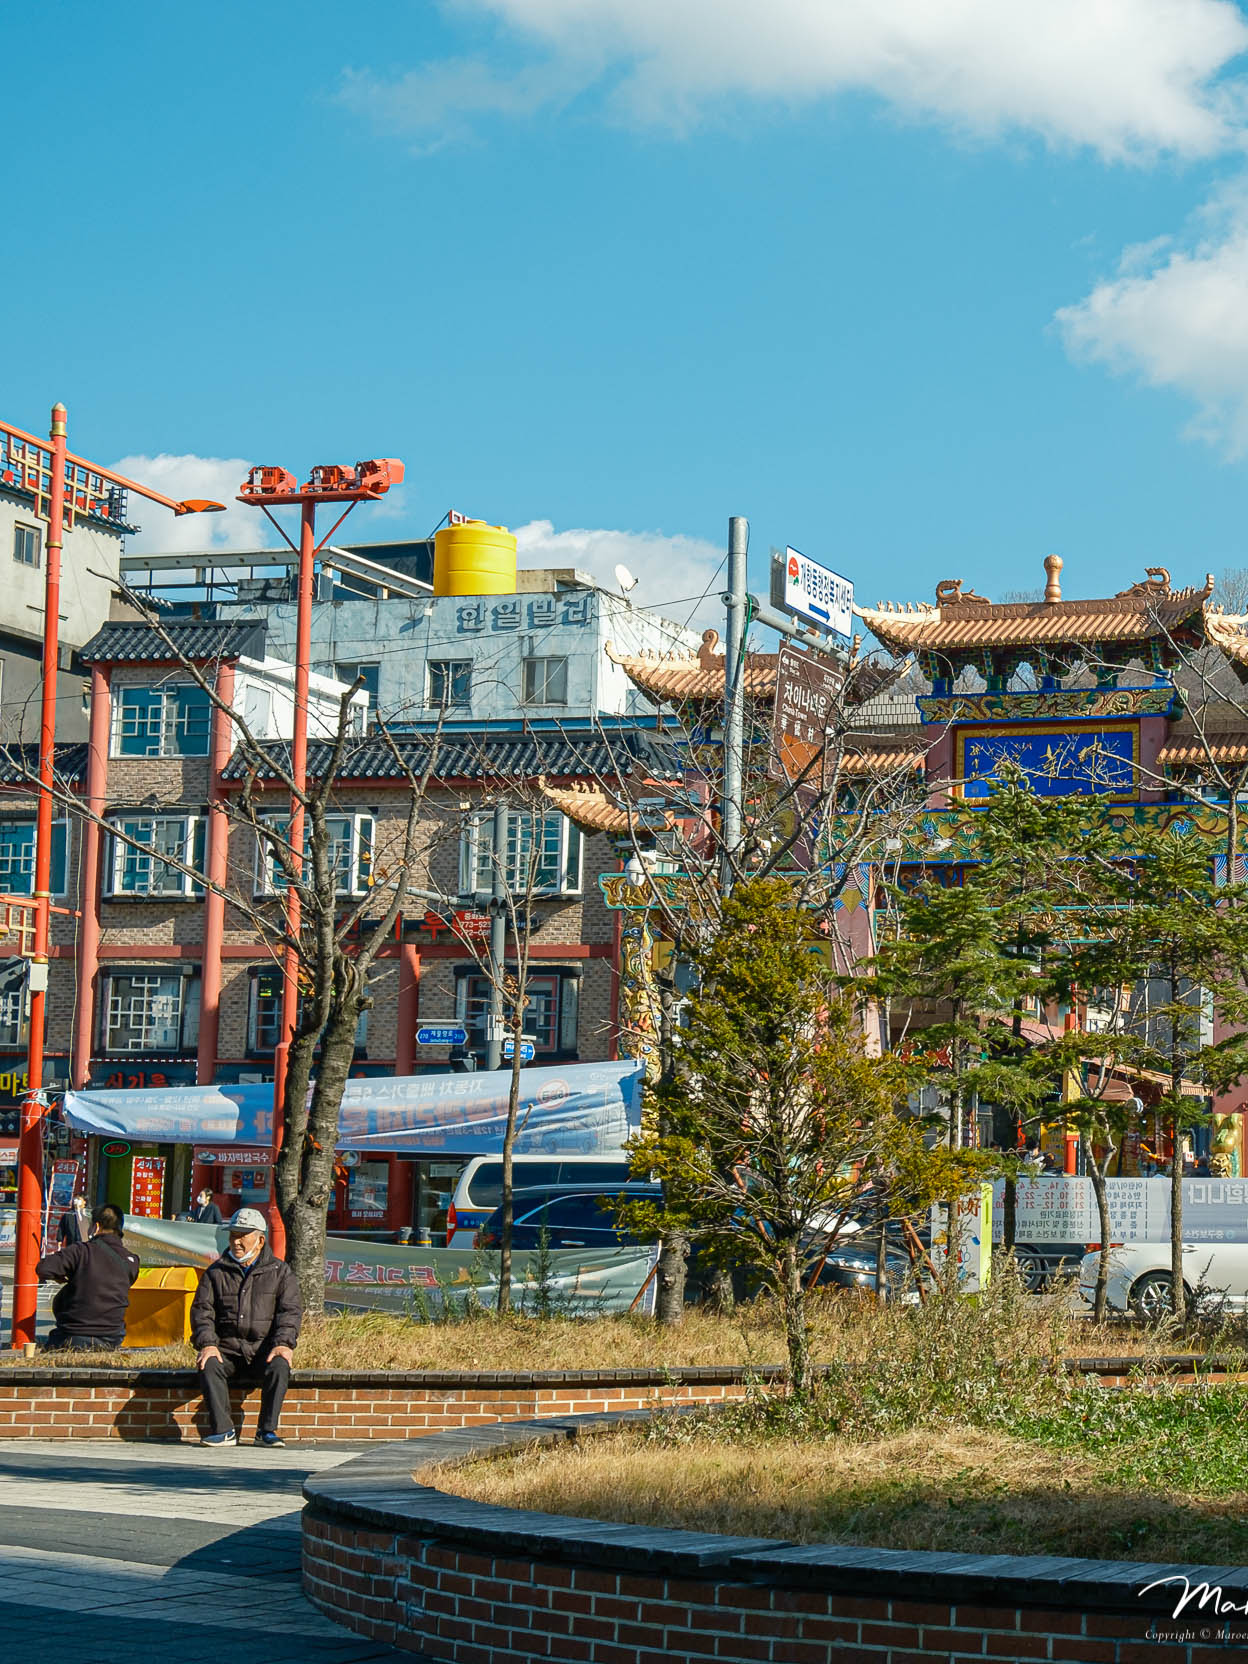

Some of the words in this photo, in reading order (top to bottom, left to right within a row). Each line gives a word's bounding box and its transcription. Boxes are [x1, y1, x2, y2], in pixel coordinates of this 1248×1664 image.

[800, 562, 853, 614] 개항동행정복지센터
[460, 592, 595, 631] 한일빌라
[783, 681, 827, 719] 차이나타운
[217, 1151, 270, 1164] 바지락칼국수
